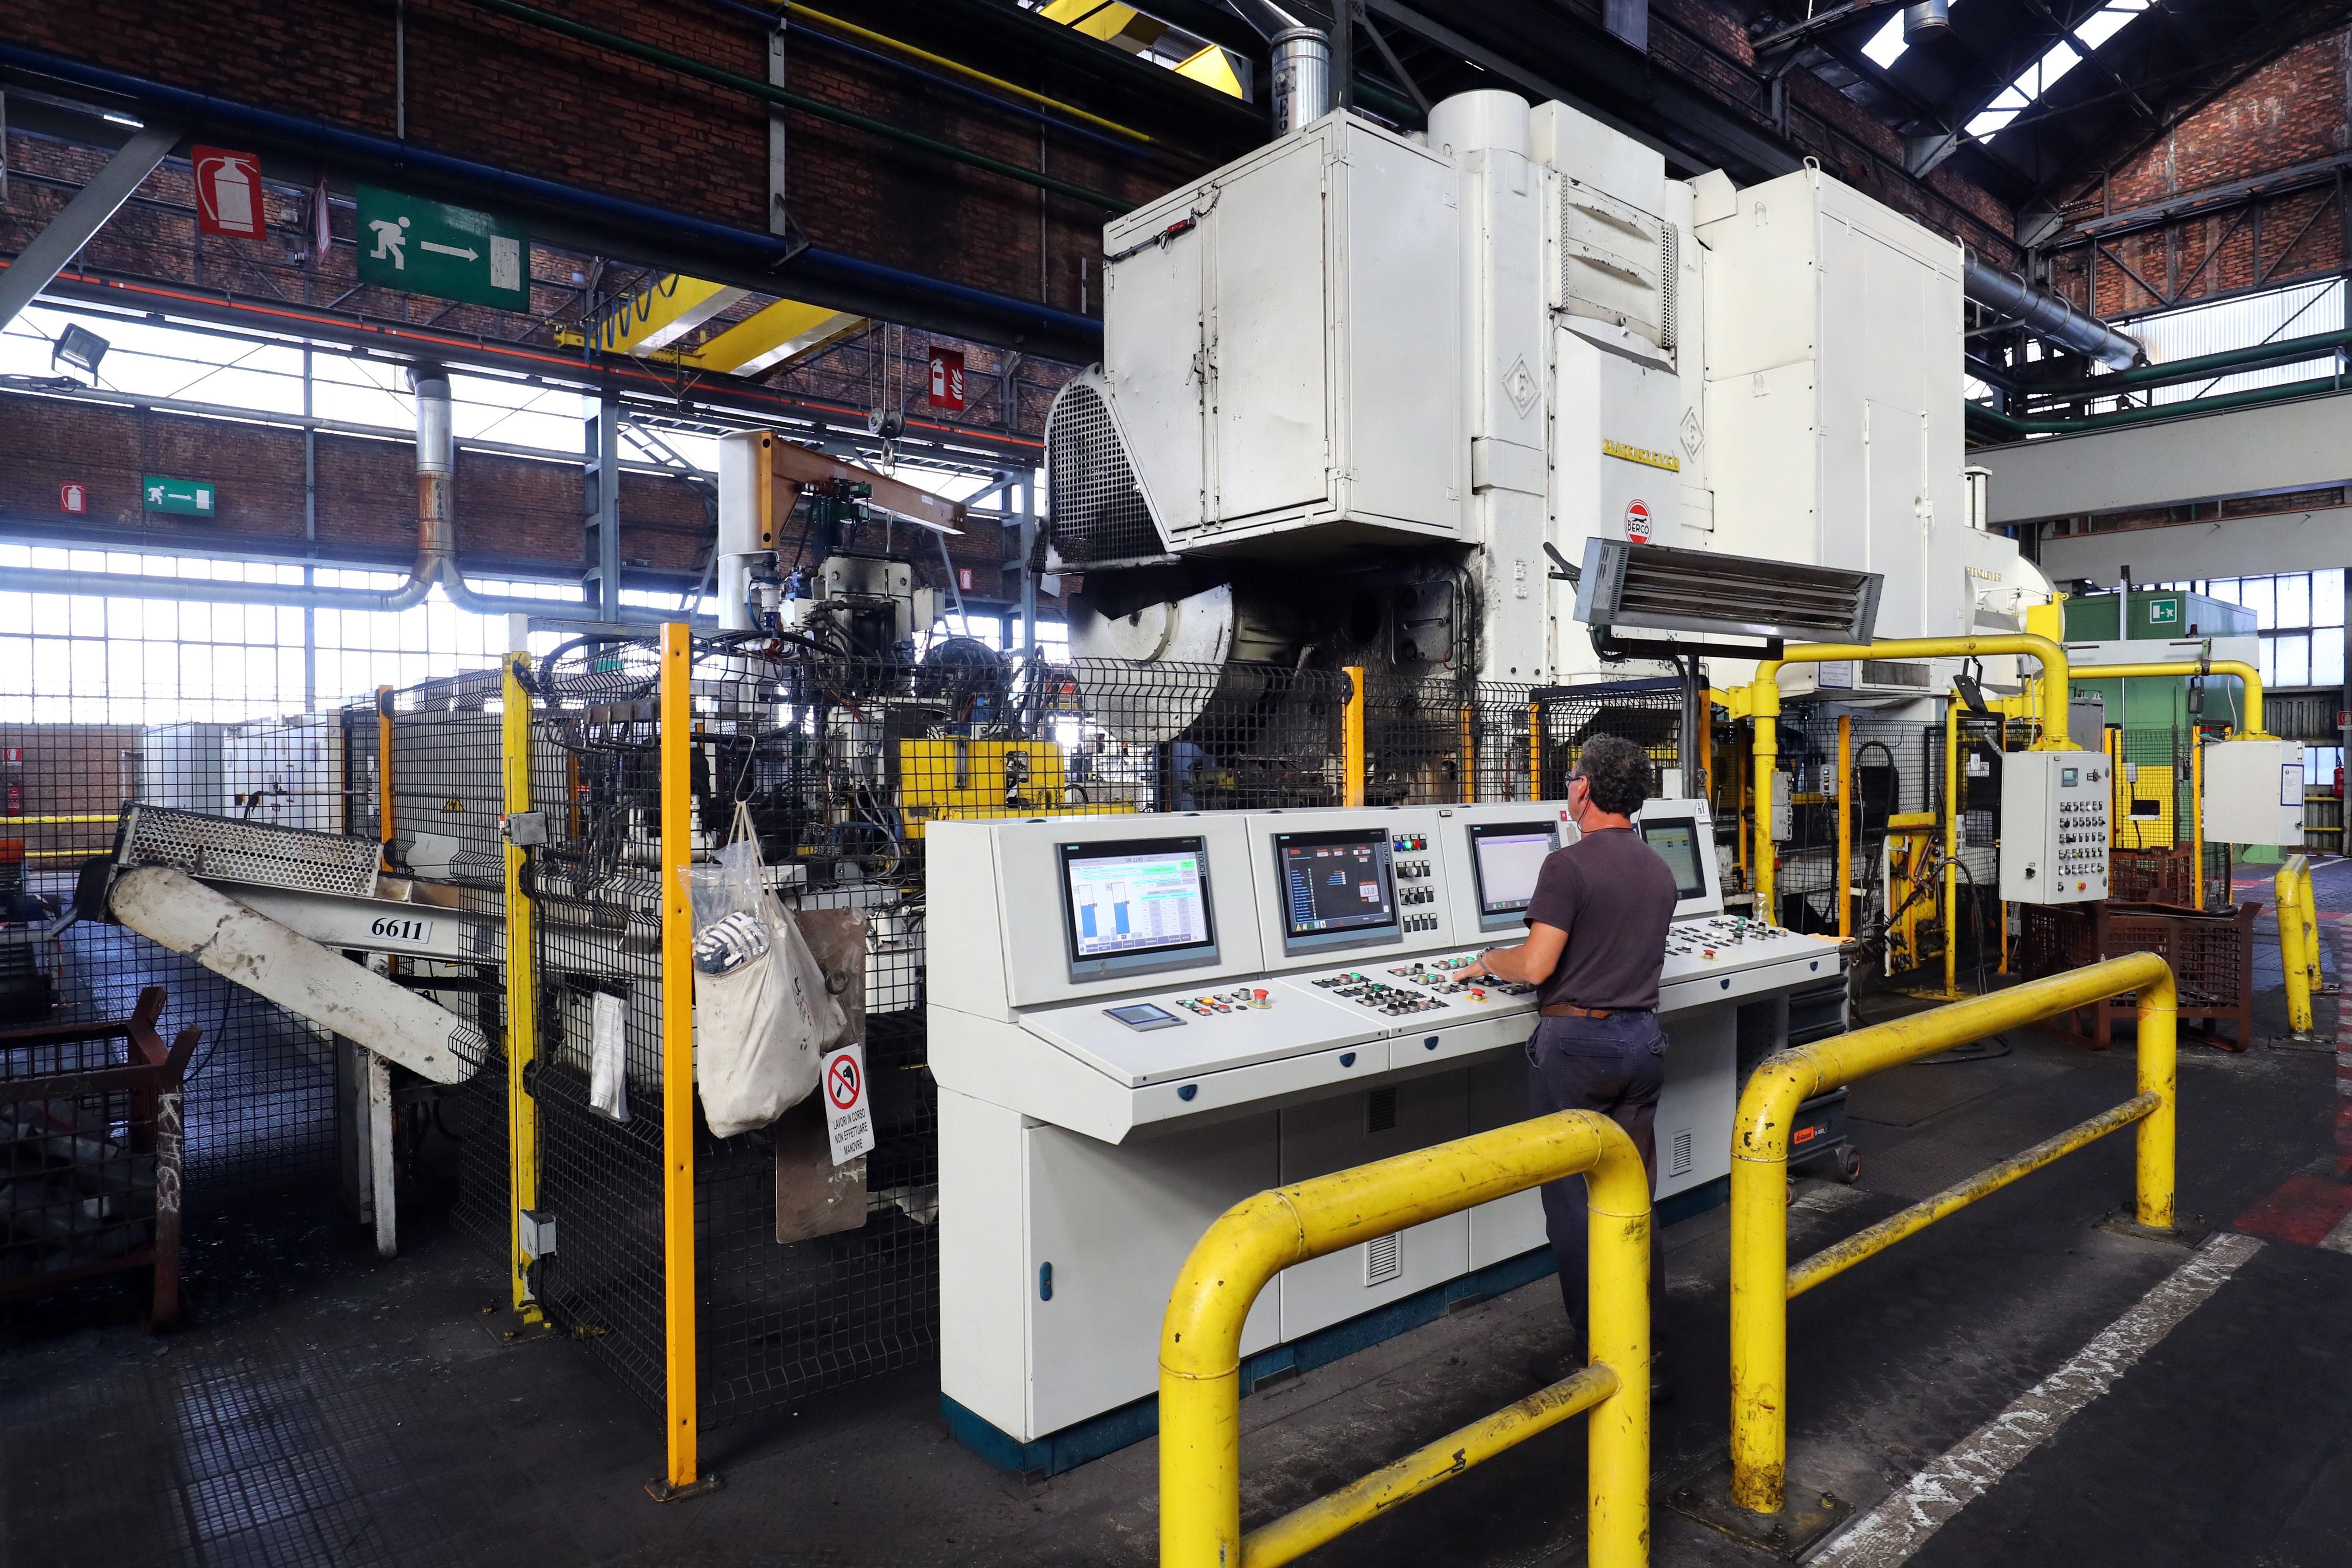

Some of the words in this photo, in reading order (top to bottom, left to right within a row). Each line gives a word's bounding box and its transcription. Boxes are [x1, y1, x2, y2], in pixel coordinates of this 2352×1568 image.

[1628, 520, 1649, 534] BERCO
[372, 917, 422, 940] 6611
[833, 1116, 847, 1130] LAVORI
[847, 1113, 852, 1124] IN
[851, 1108, 865, 1122] CORSO
[835, 1131, 844, 1144] NON
[844, 1122, 868, 1140] EFFETTUARE
[843, 1139, 863, 1155] MANOVRE
